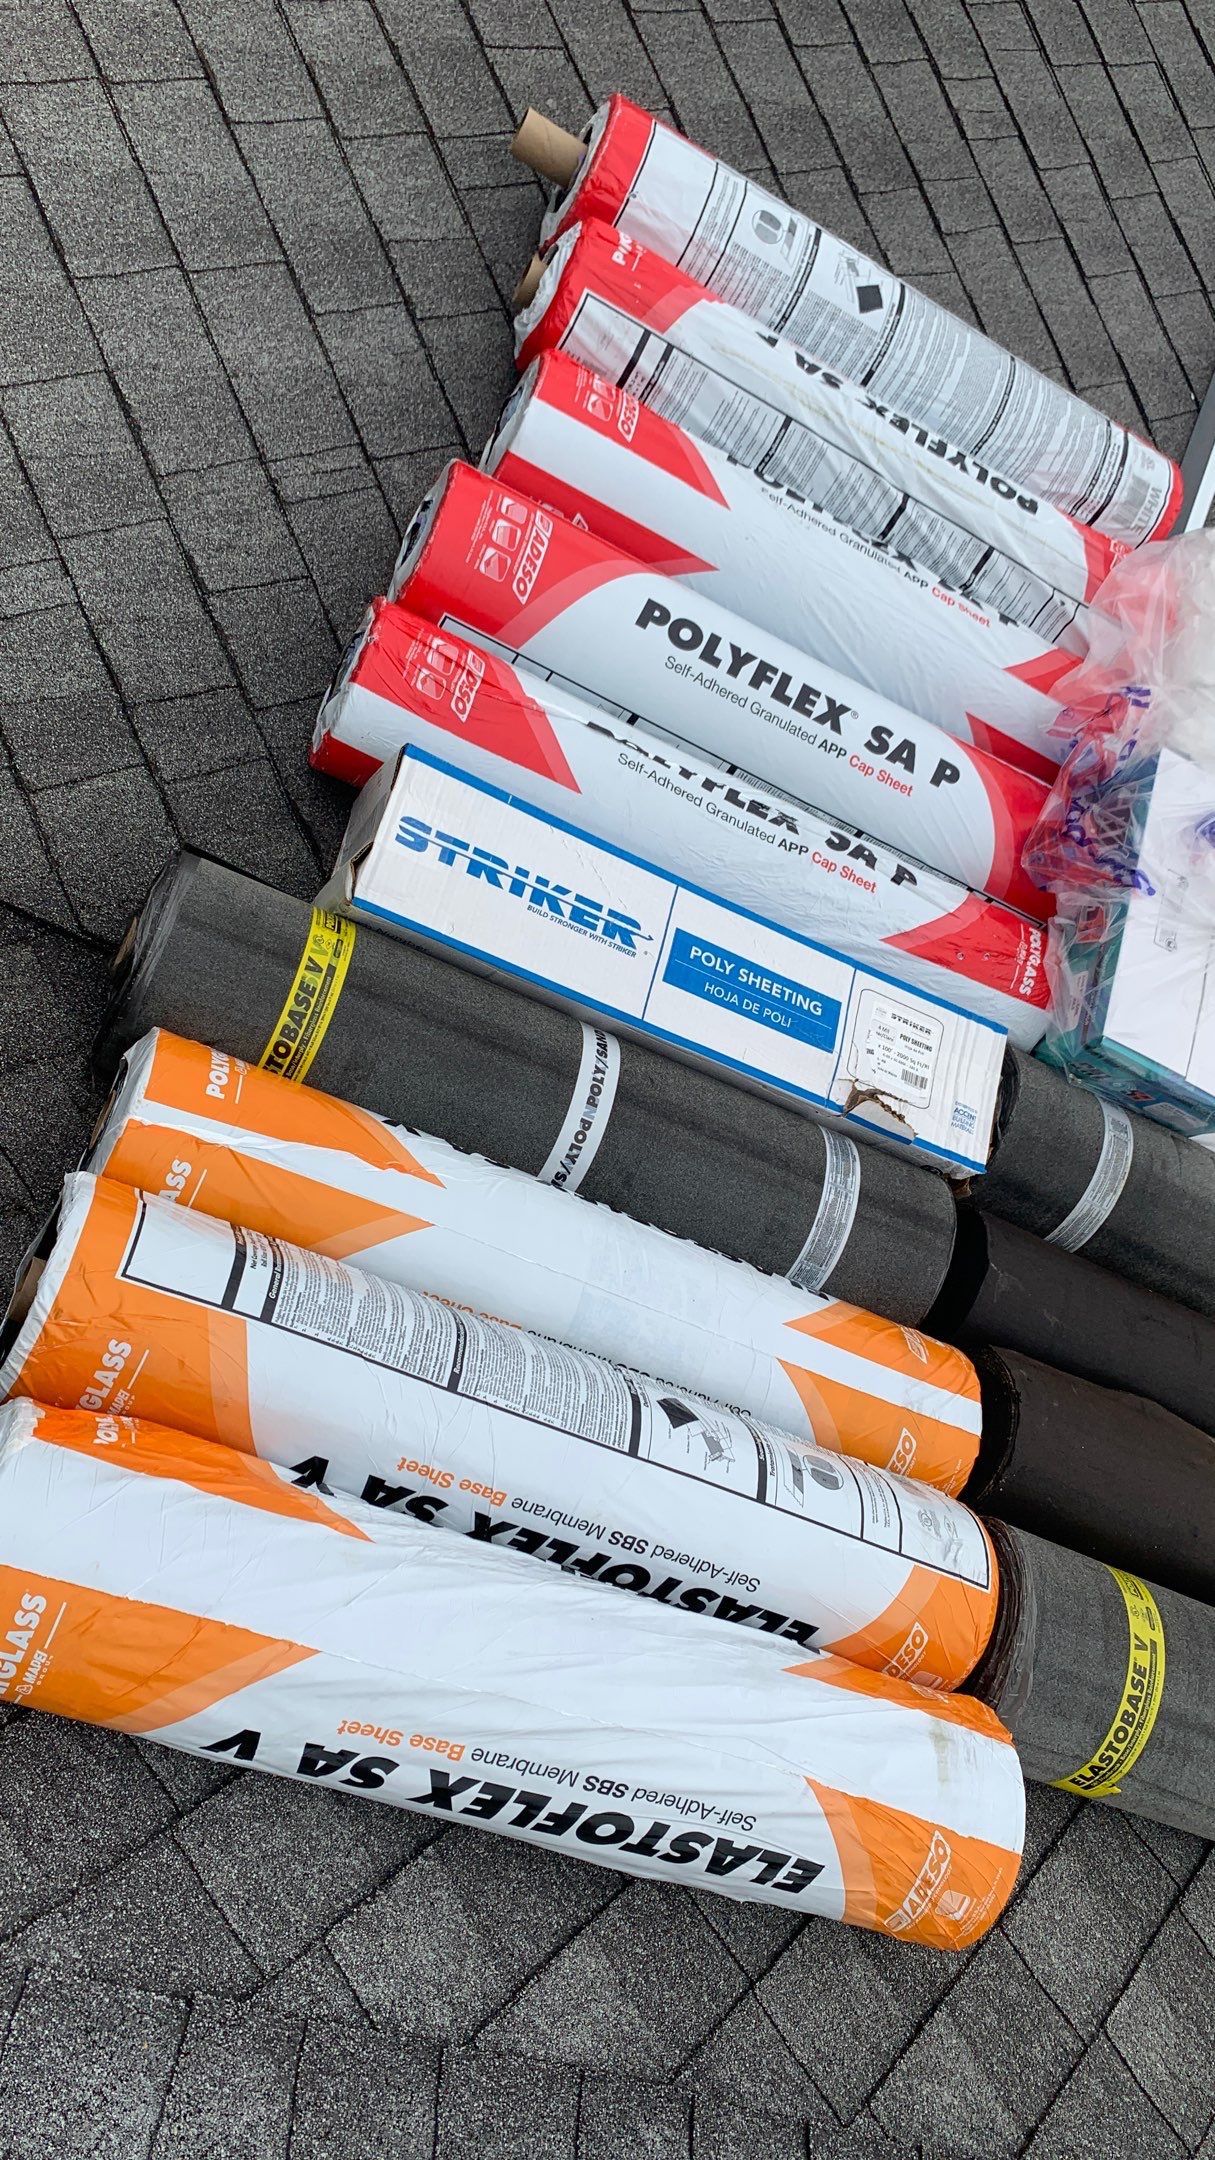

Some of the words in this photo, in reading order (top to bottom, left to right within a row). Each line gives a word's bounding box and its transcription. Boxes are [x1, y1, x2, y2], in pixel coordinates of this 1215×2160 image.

[1130, 486, 1163, 536] WHITE
[514, 529, 548, 602] ADESO
[903, 571, 929, 590] APP
[931, 586, 956, 608] Cap
[634, 597, 853, 735] POLYFLEX
[864, 725, 918, 775] SA
[929, 757, 961, 788] P
[664, 655, 747, 708] Self-Adhered
[749, 701, 818, 746] Granulated
[817, 738, 848, 760] APP
[848, 753, 875, 779] Cap
[876, 765, 914, 797] Sheet
[617, 752, 703, 807] Self-Adhered
[705, 802, 776, 845] Granulated
[777, 837, 809, 857] APP
[811, 851, 838, 876] Cap
[839, 861, 877, 894] Sheet
[395, 815, 653, 950] STRIKER
[526, 904, 549, 919] BUILD
[549, 913, 589, 937] STRONGER
[588, 932, 608, 947] WITH
[607, 940, 638, 959] STRIKER
[689, 945, 735, 976] POLY
[738, 967, 823, 1016] SHEETING
[1018, 926, 1042, 997] POLYGLASS
[703, 981, 739, 1007] HOJA
[742, 998, 760, 1015] DE
[762, 1006, 792, 1029] POLI
[268, 1271, 281, 1298] General
[289, 1455, 335, 1498] V
[397, 1456, 455, 1489] Sheet
[458, 1478, 507, 1507] Base
[360, 1474, 448, 1528] SA
[511, 1497, 606, 1540] Membrane
[607, 1530, 649, 1554] SBS
[650, 1544, 761, 1592] Self-Adhered
[26, 1647, 49, 1687] MAPEI
[885, 1627, 927, 1678] DESO
[336, 1719, 404, 1747] Sheet
[1069, 1660, 1147, 1787] ELASTOBASE
[1133, 1631, 1149, 1652] V
[199, 1729, 261, 1761] V
[297, 1742, 400, 1789] SA
[409, 1733, 466, 1762] Base
[471, 1748, 579, 1787] Membrane
[582, 1774, 630, 1799] SBS
[631, 1786, 757, 1831] Self-Adhered
[405, 1768, 826, 1893] ELASTOFLEX
[902, 1836, 950, 1913] ADESO
